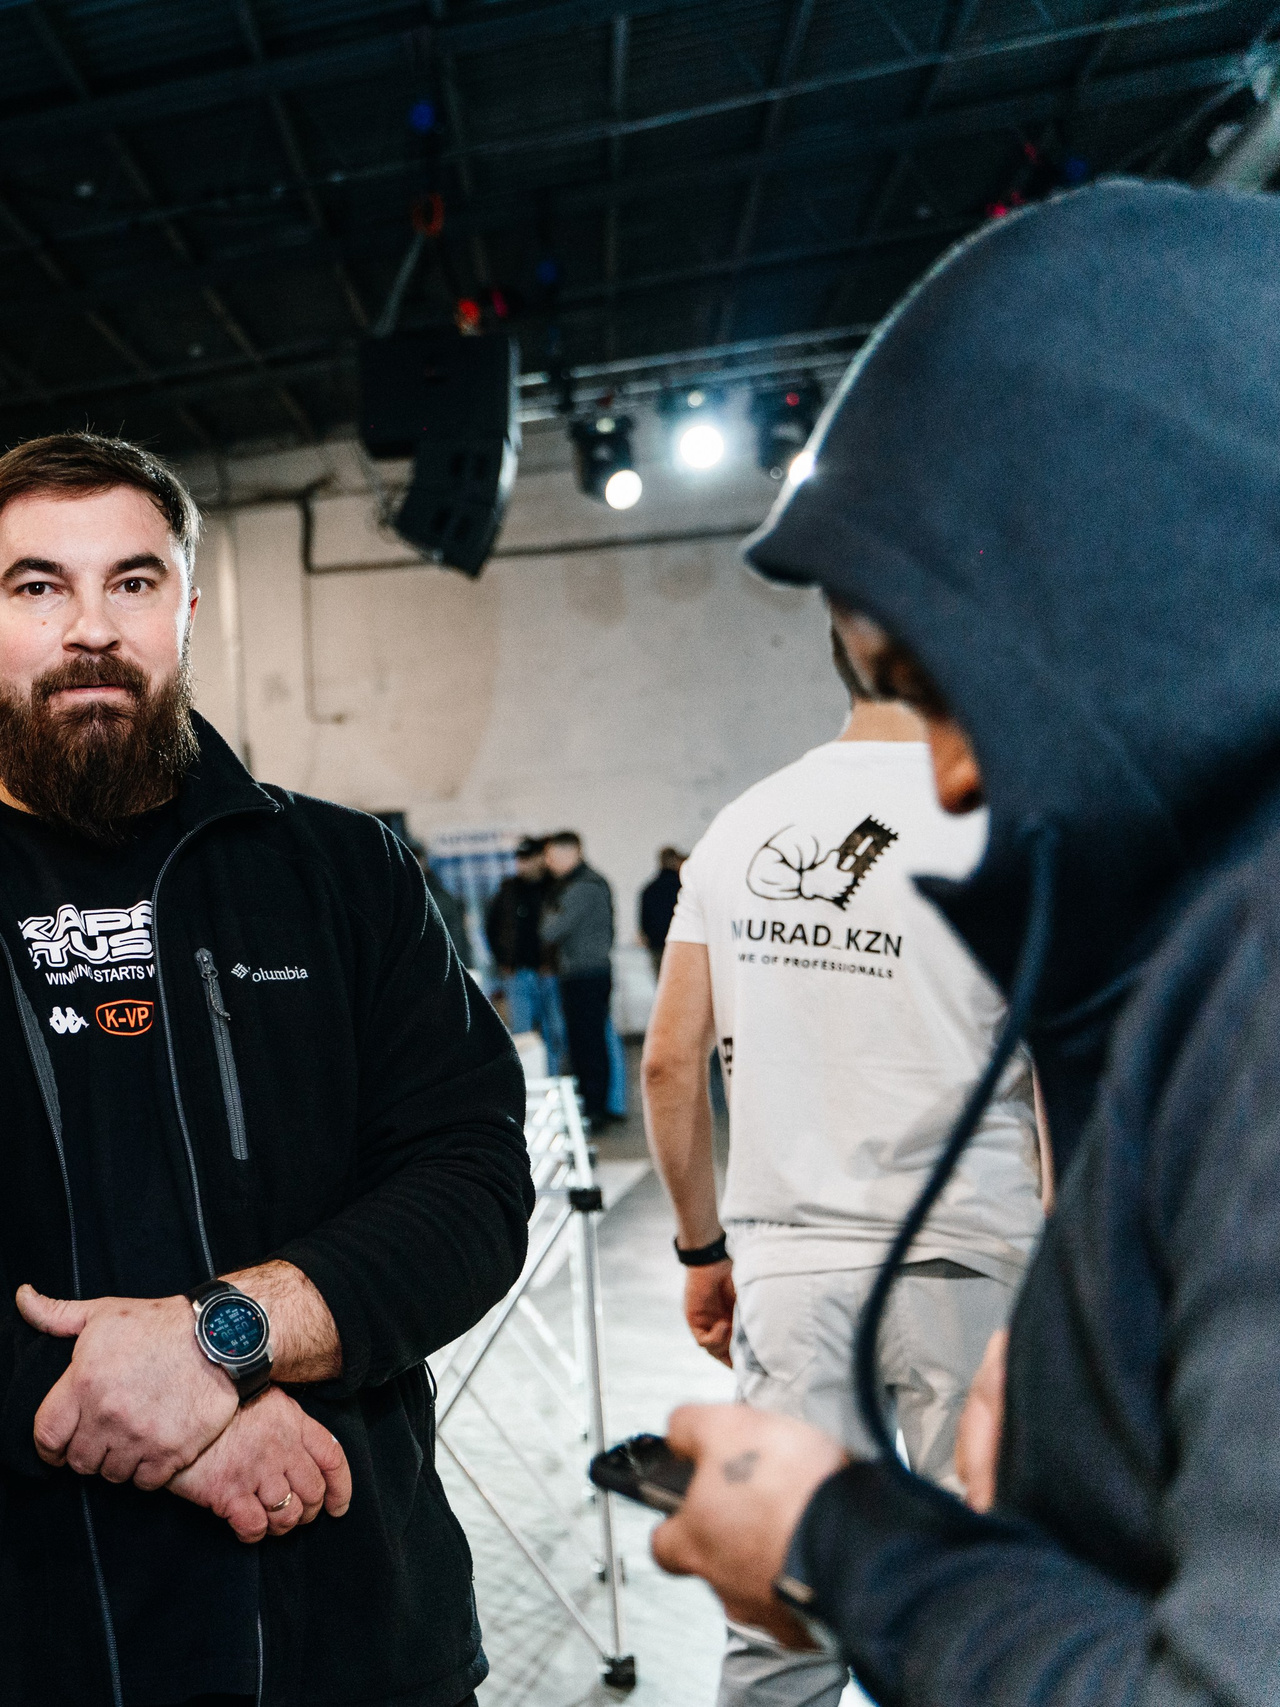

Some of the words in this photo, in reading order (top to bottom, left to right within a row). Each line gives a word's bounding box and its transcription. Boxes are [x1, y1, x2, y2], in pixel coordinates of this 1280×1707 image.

[93, 965, 145, 983] STARTS
[248, 965, 309, 982] olumbia
[783, 956, 894, 980] PROFESSIONALS
[104, 1006, 150, 1028] K-VP
